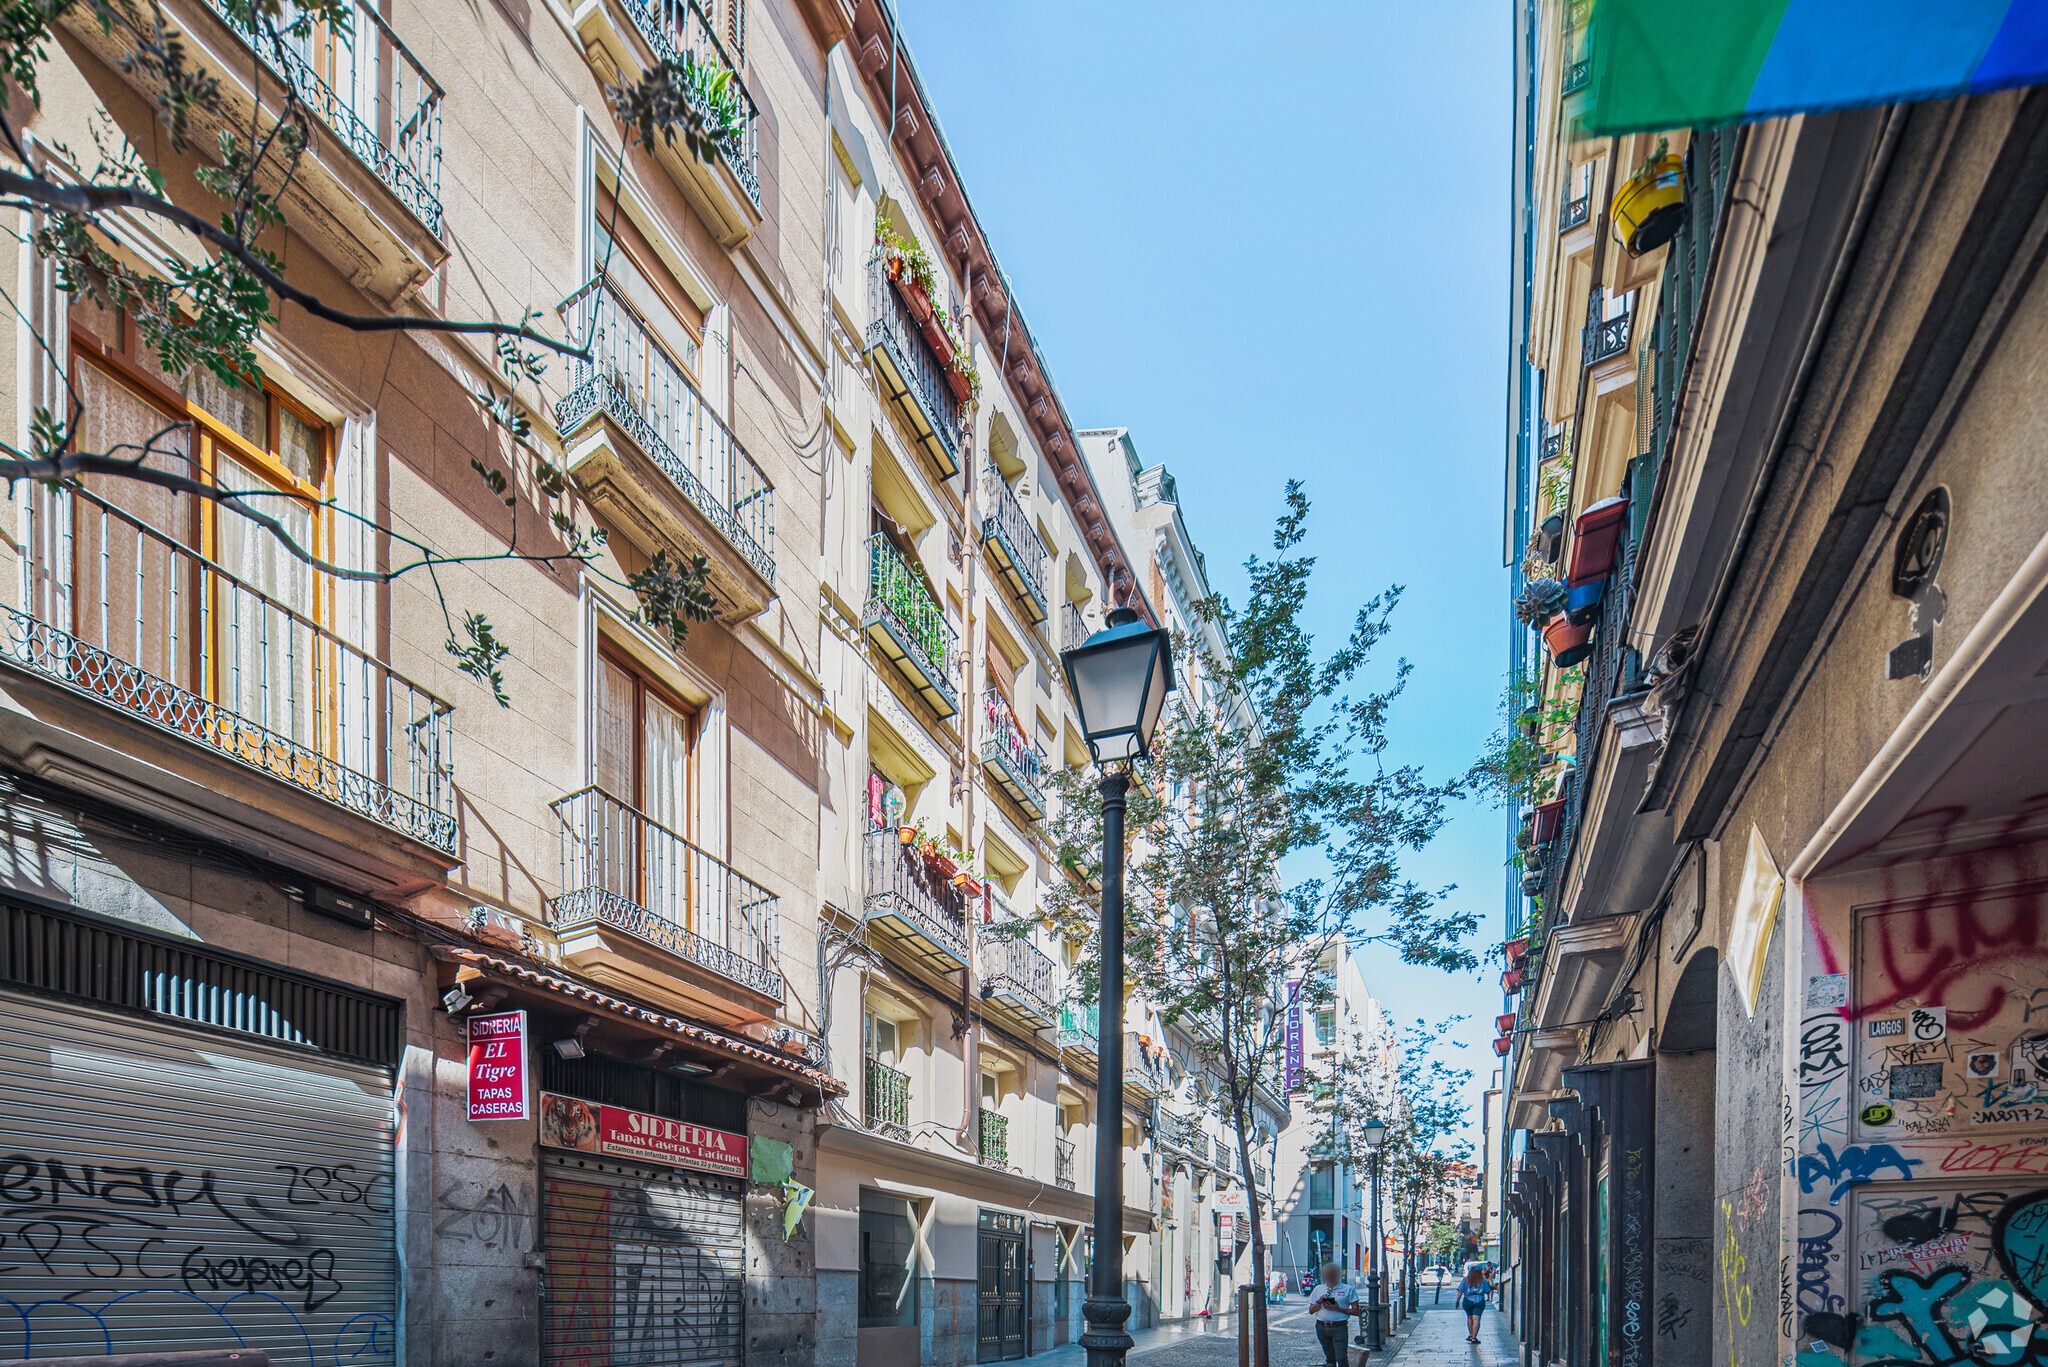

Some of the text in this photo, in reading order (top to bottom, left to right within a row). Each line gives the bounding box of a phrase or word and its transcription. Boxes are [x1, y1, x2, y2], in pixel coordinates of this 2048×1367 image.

[472, 1017, 521, 1036] SIDRERIA
[1871, 1022, 1902, 1036] LARGOS
[484, 1042, 507, 1059] EL
[476, 1063, 516, 1082] Tigre
[477, 1087, 512, 1100] TAPAS
[471, 1102, 522, 1115] CASERAS
[628, 1113, 727, 1151] SIDRERIA
[609, 1129, 646, 1146] Tapas
[648, 1138, 691, 1155] Caseras
[698, 1147, 741, 1164] Raciones
[607, 1143, 635, 1155] Estamos
[635, 1148, 644, 1156] en
[645, 1150, 668, 1161] Infantas
[678, 1156, 700, 1167] Infantas
[712, 1163, 735, 1173] Hortaleza
